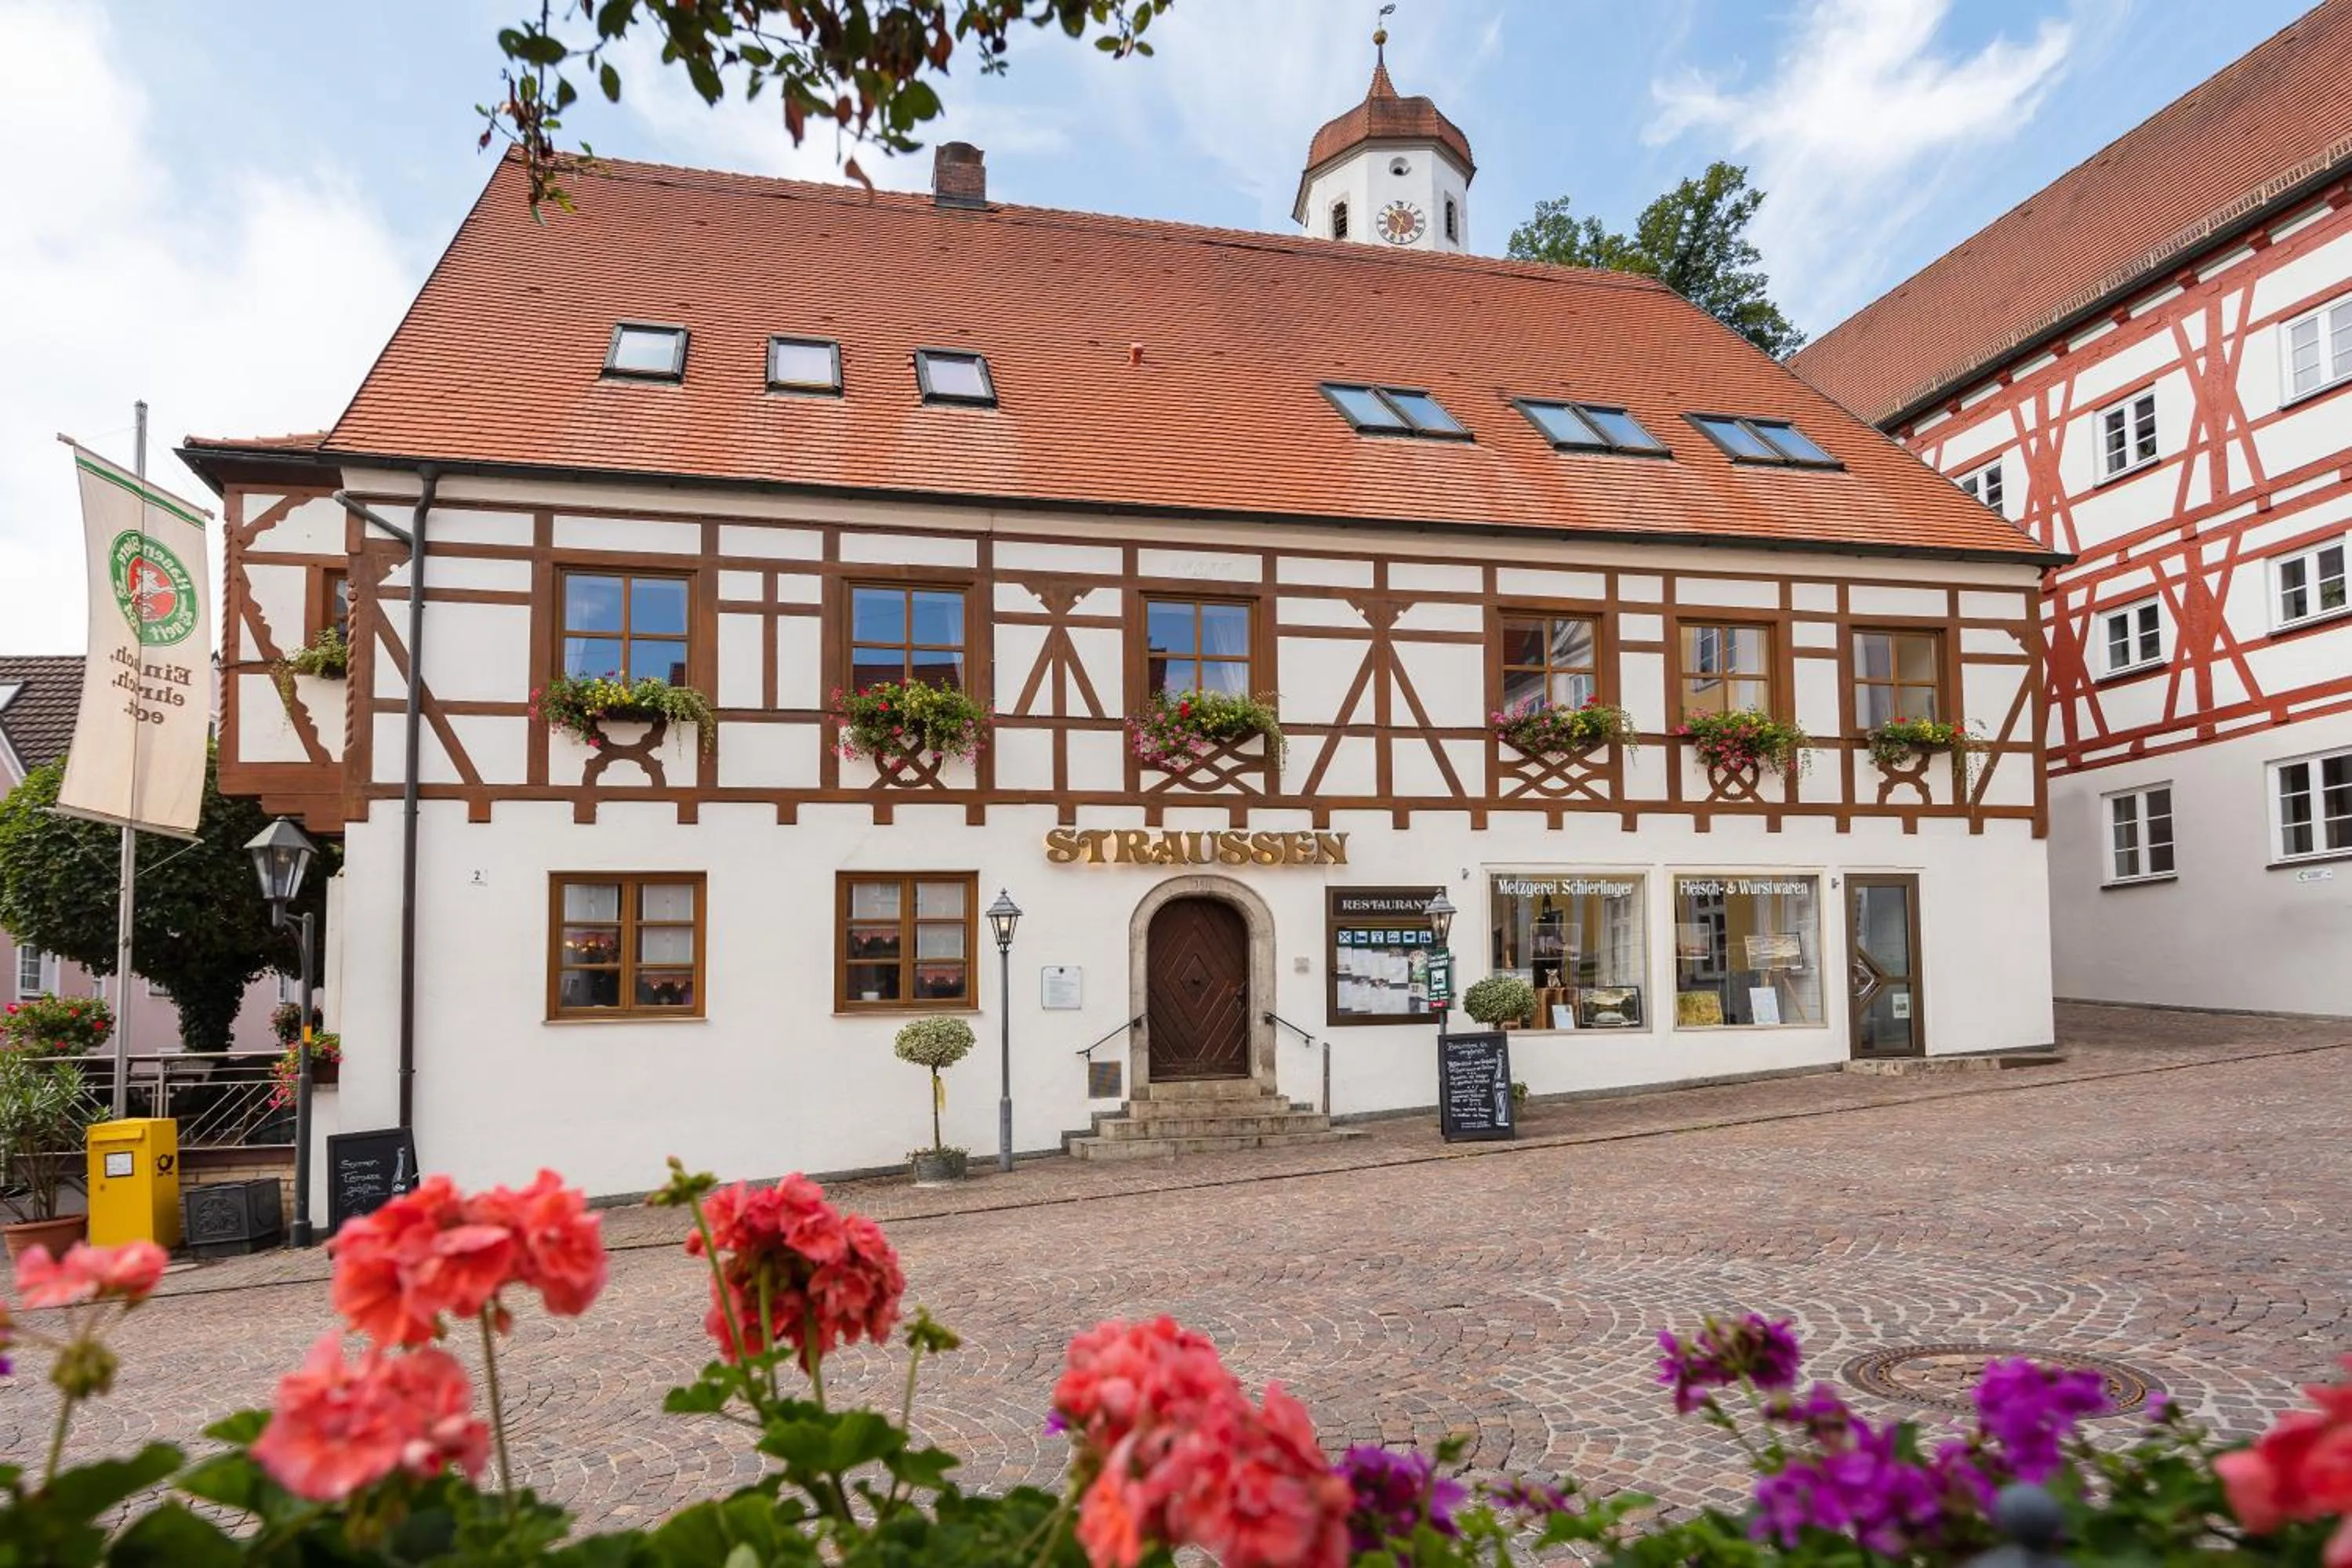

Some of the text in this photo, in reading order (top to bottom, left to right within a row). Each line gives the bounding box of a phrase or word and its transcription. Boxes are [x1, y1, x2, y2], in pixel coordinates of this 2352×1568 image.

[1046, 828, 1350, 866] STRAUSSEN
[1498, 879, 1557, 898] Metzgerei
[1680, 879, 1808, 896] Fleisch- & Wurstwaren
[1341, 898, 1432, 910] RESTAURANT
